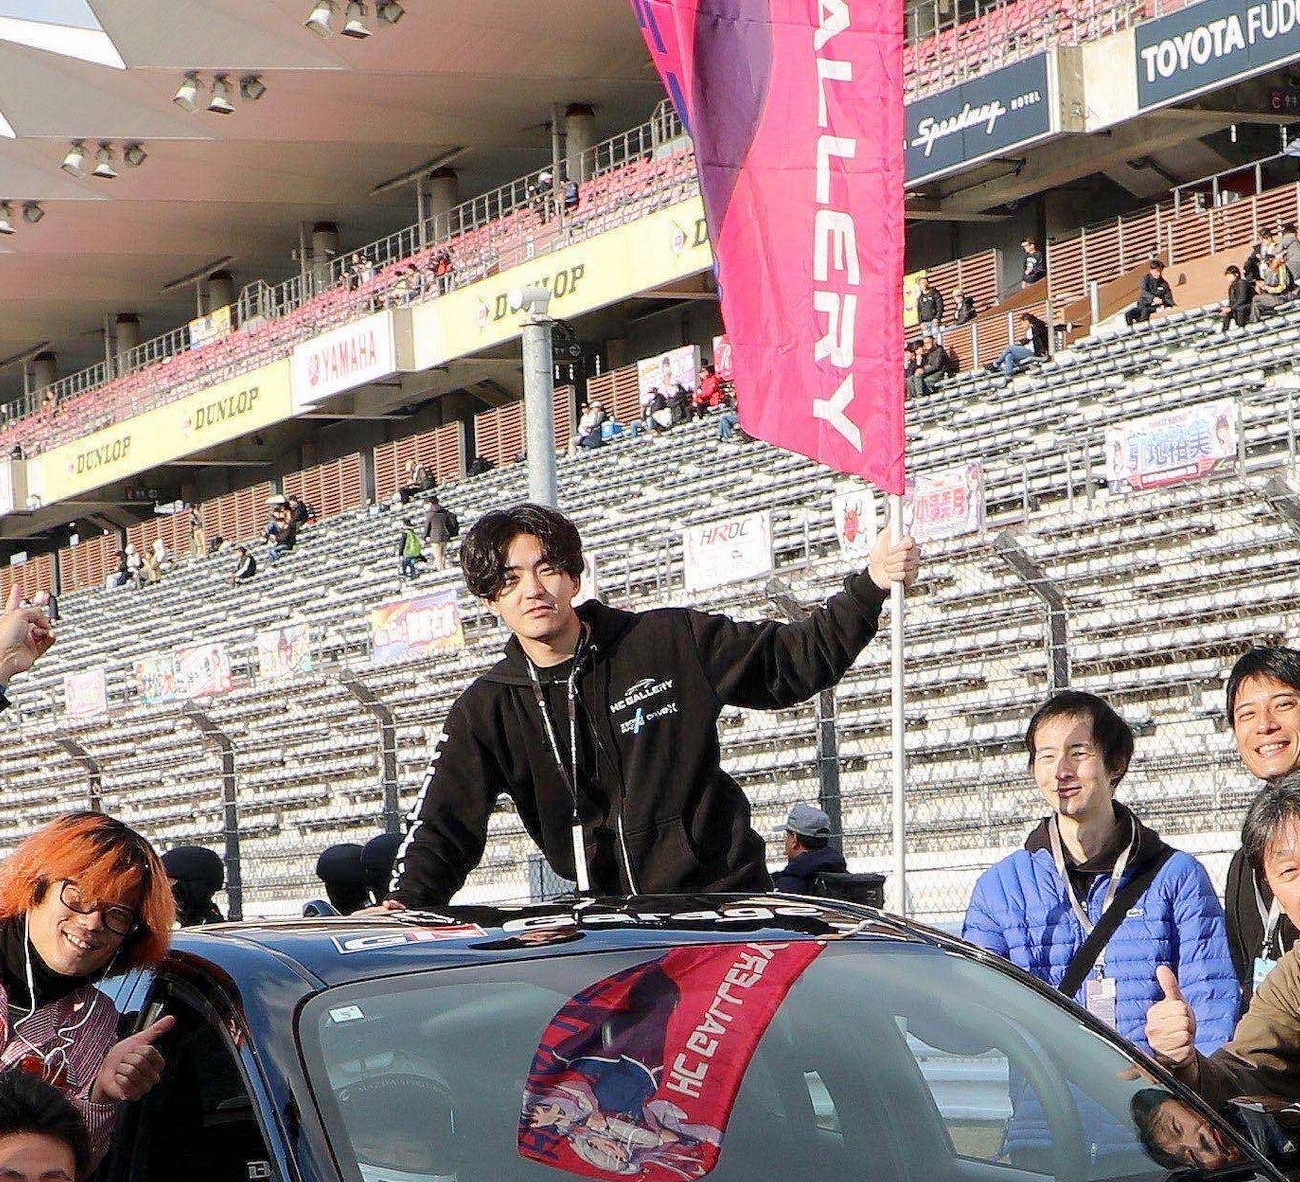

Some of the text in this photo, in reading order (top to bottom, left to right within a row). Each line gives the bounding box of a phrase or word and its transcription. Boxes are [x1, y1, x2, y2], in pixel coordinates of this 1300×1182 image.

[1141, 19, 1246, 83] TOYOTA
[912, 91, 1043, 158] Speedway HOTEL
[322, 330, 378, 384] YAMAHA
[194, 386, 260, 431] DUNLOP
[76, 435, 132, 475] DUNLOP
